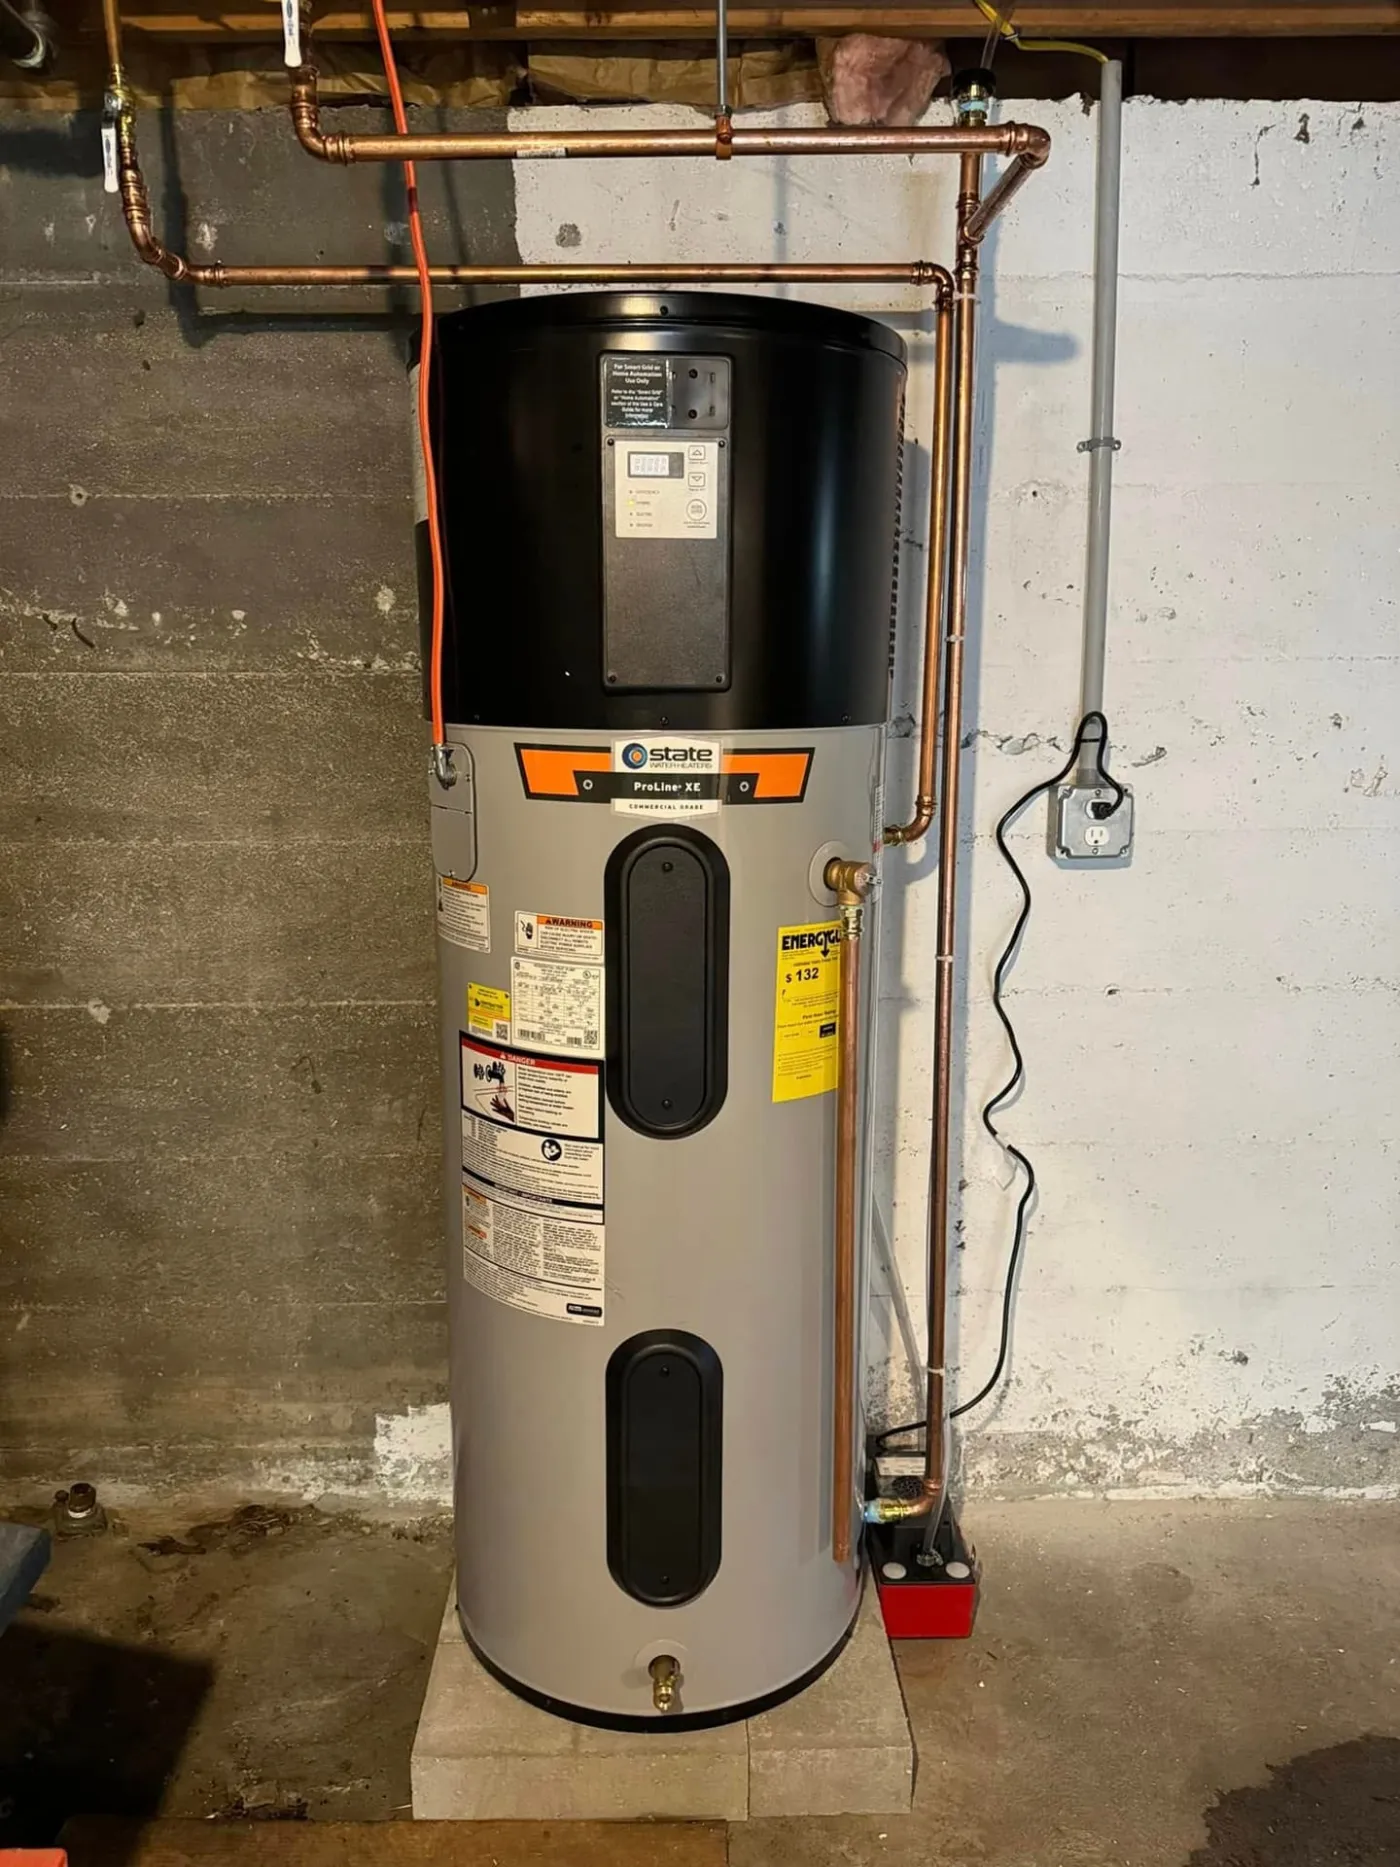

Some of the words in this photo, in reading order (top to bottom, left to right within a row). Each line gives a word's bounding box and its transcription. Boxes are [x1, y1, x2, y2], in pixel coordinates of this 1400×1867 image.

[650, 747, 712, 761] state
[685, 783, 700, 791] XE
[551, 918, 592, 928] WARNING
[796, 968, 819, 981] 132
[507, 1054, 535, 1065] DANGER
